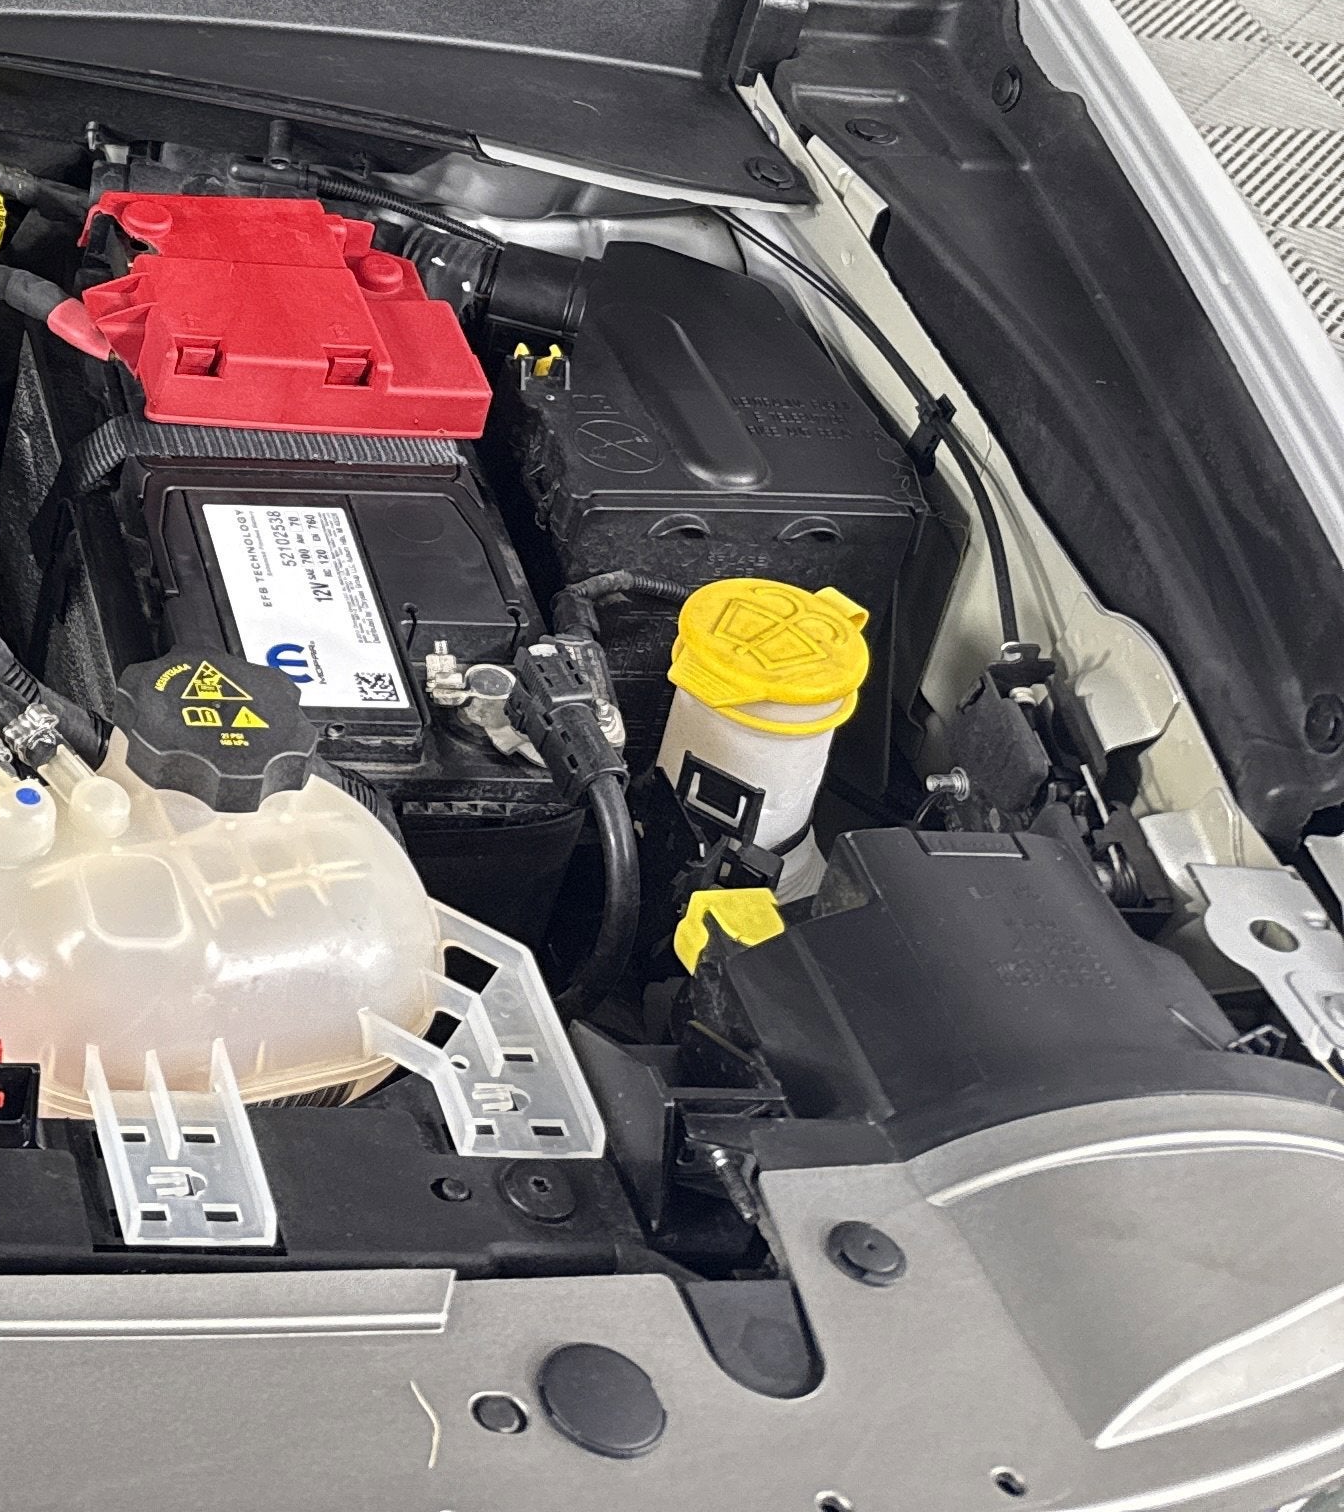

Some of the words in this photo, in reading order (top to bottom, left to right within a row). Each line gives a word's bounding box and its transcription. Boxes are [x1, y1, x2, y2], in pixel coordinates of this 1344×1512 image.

[305, 514, 318, 529] 760
[235, 509, 264, 581] TECHNOLOGY
[266, 510, 297, 566] 52102538
[299, 548, 313, 564] 700
[316, 549, 330, 564] 120
[258, 587, 272, 607] EFB
[312, 581, 334, 602] 12V
[308, 644, 326, 684] MOPAR
